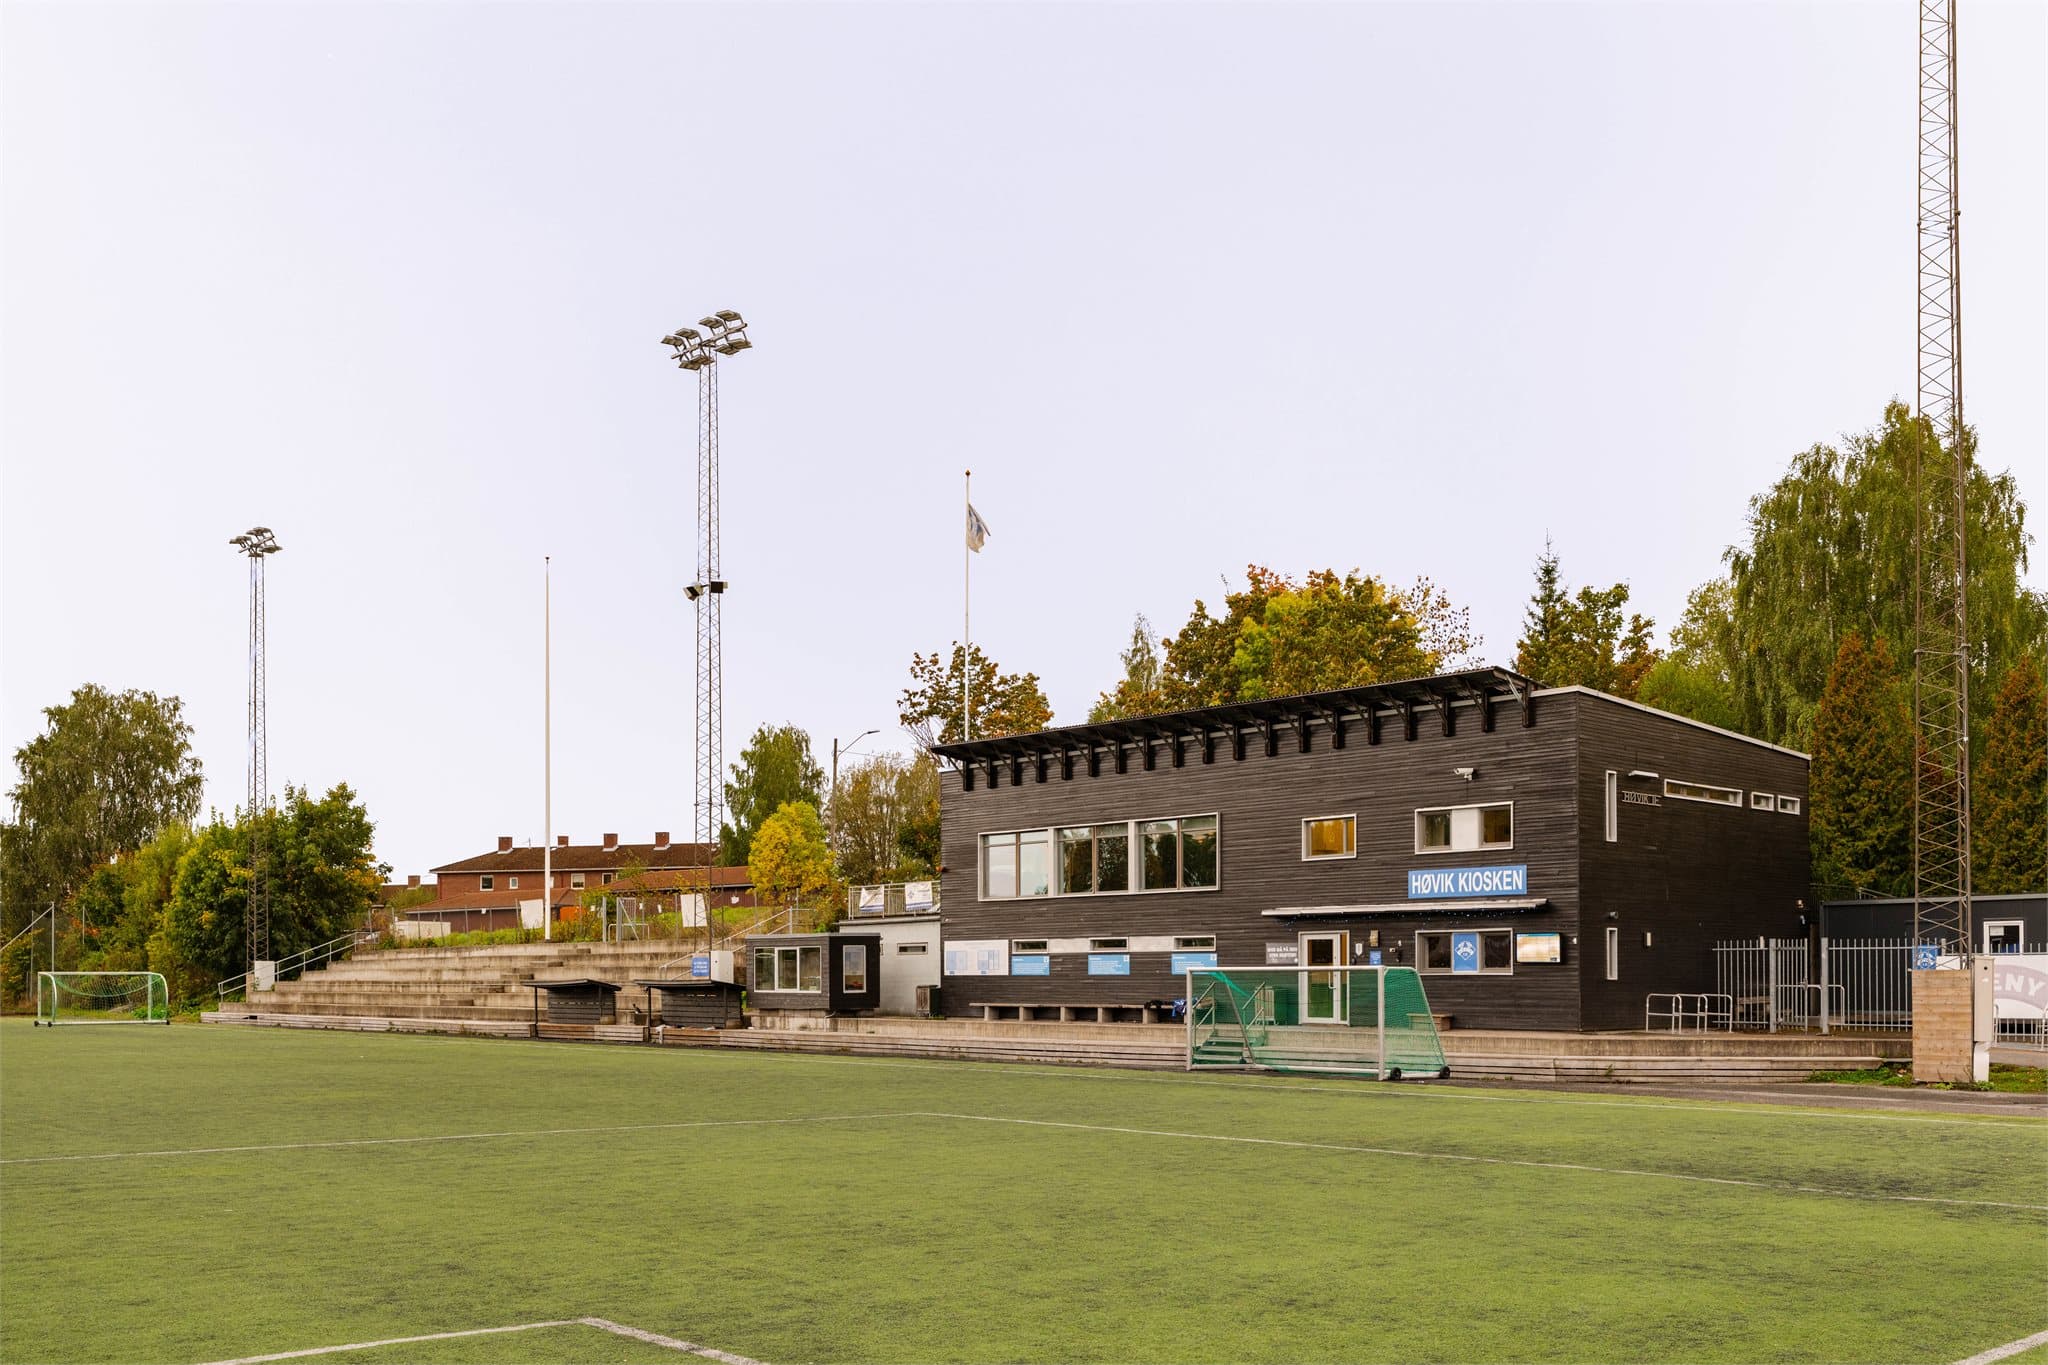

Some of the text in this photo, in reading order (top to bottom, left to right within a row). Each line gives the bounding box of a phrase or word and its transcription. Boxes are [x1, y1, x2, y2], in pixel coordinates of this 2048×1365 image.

[1412, 869, 1522, 894] HØVIK KIOSKEN
[1994, 972, 2046, 997] ENY
